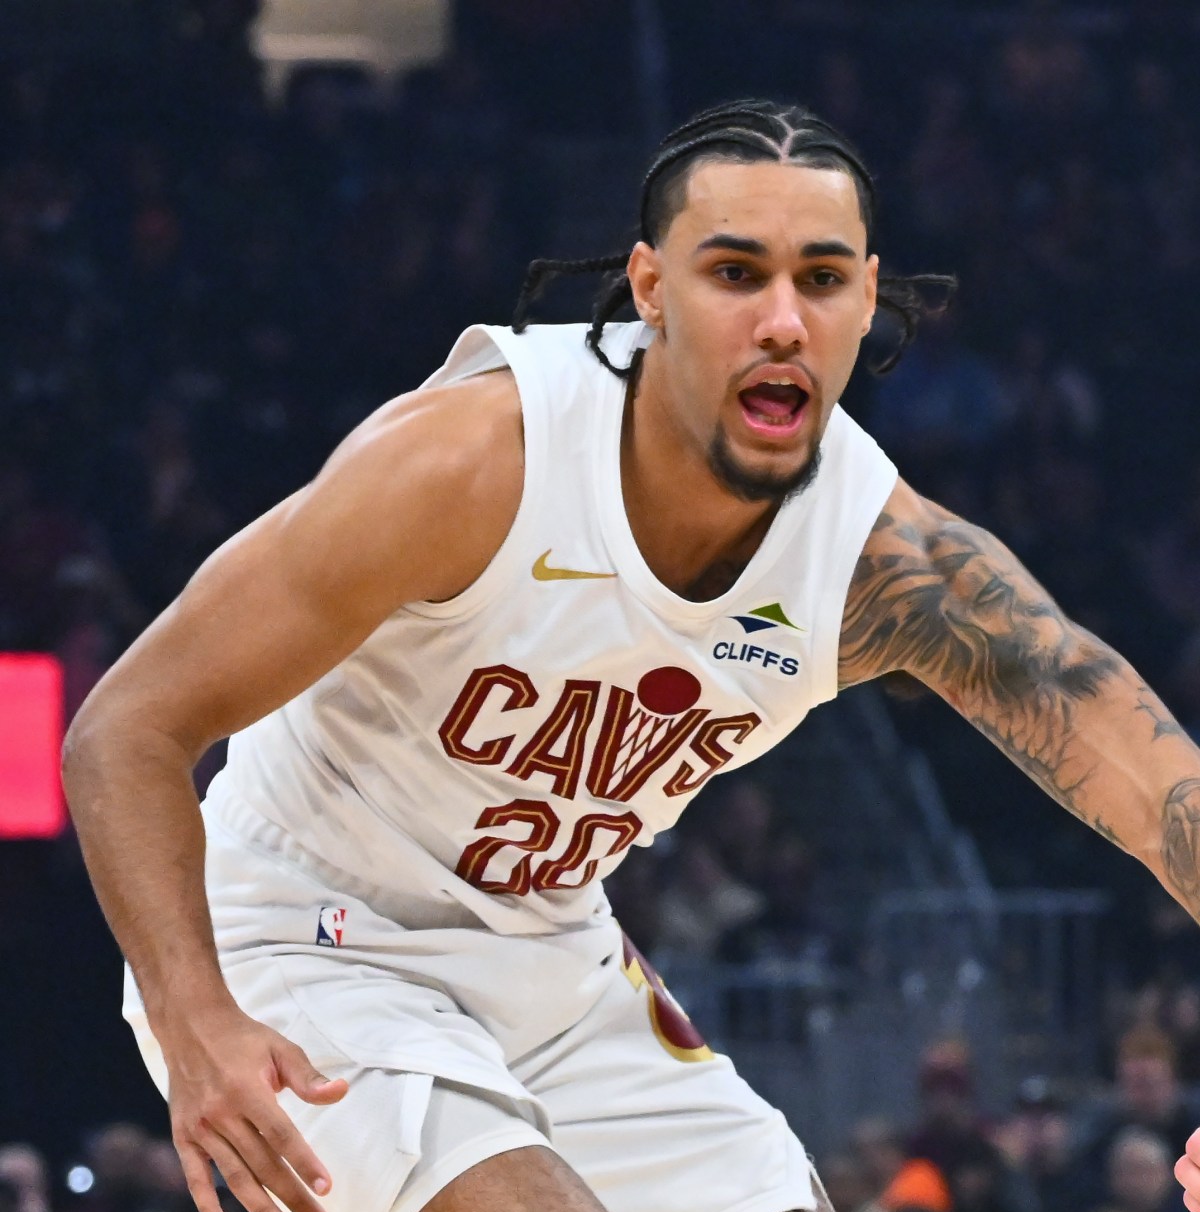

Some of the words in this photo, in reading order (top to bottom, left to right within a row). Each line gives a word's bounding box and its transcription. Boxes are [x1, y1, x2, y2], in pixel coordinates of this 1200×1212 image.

[713, 641, 799, 676] CLIFFS
[438, 664, 762, 802] CAVS
[455, 798, 643, 896] 20
